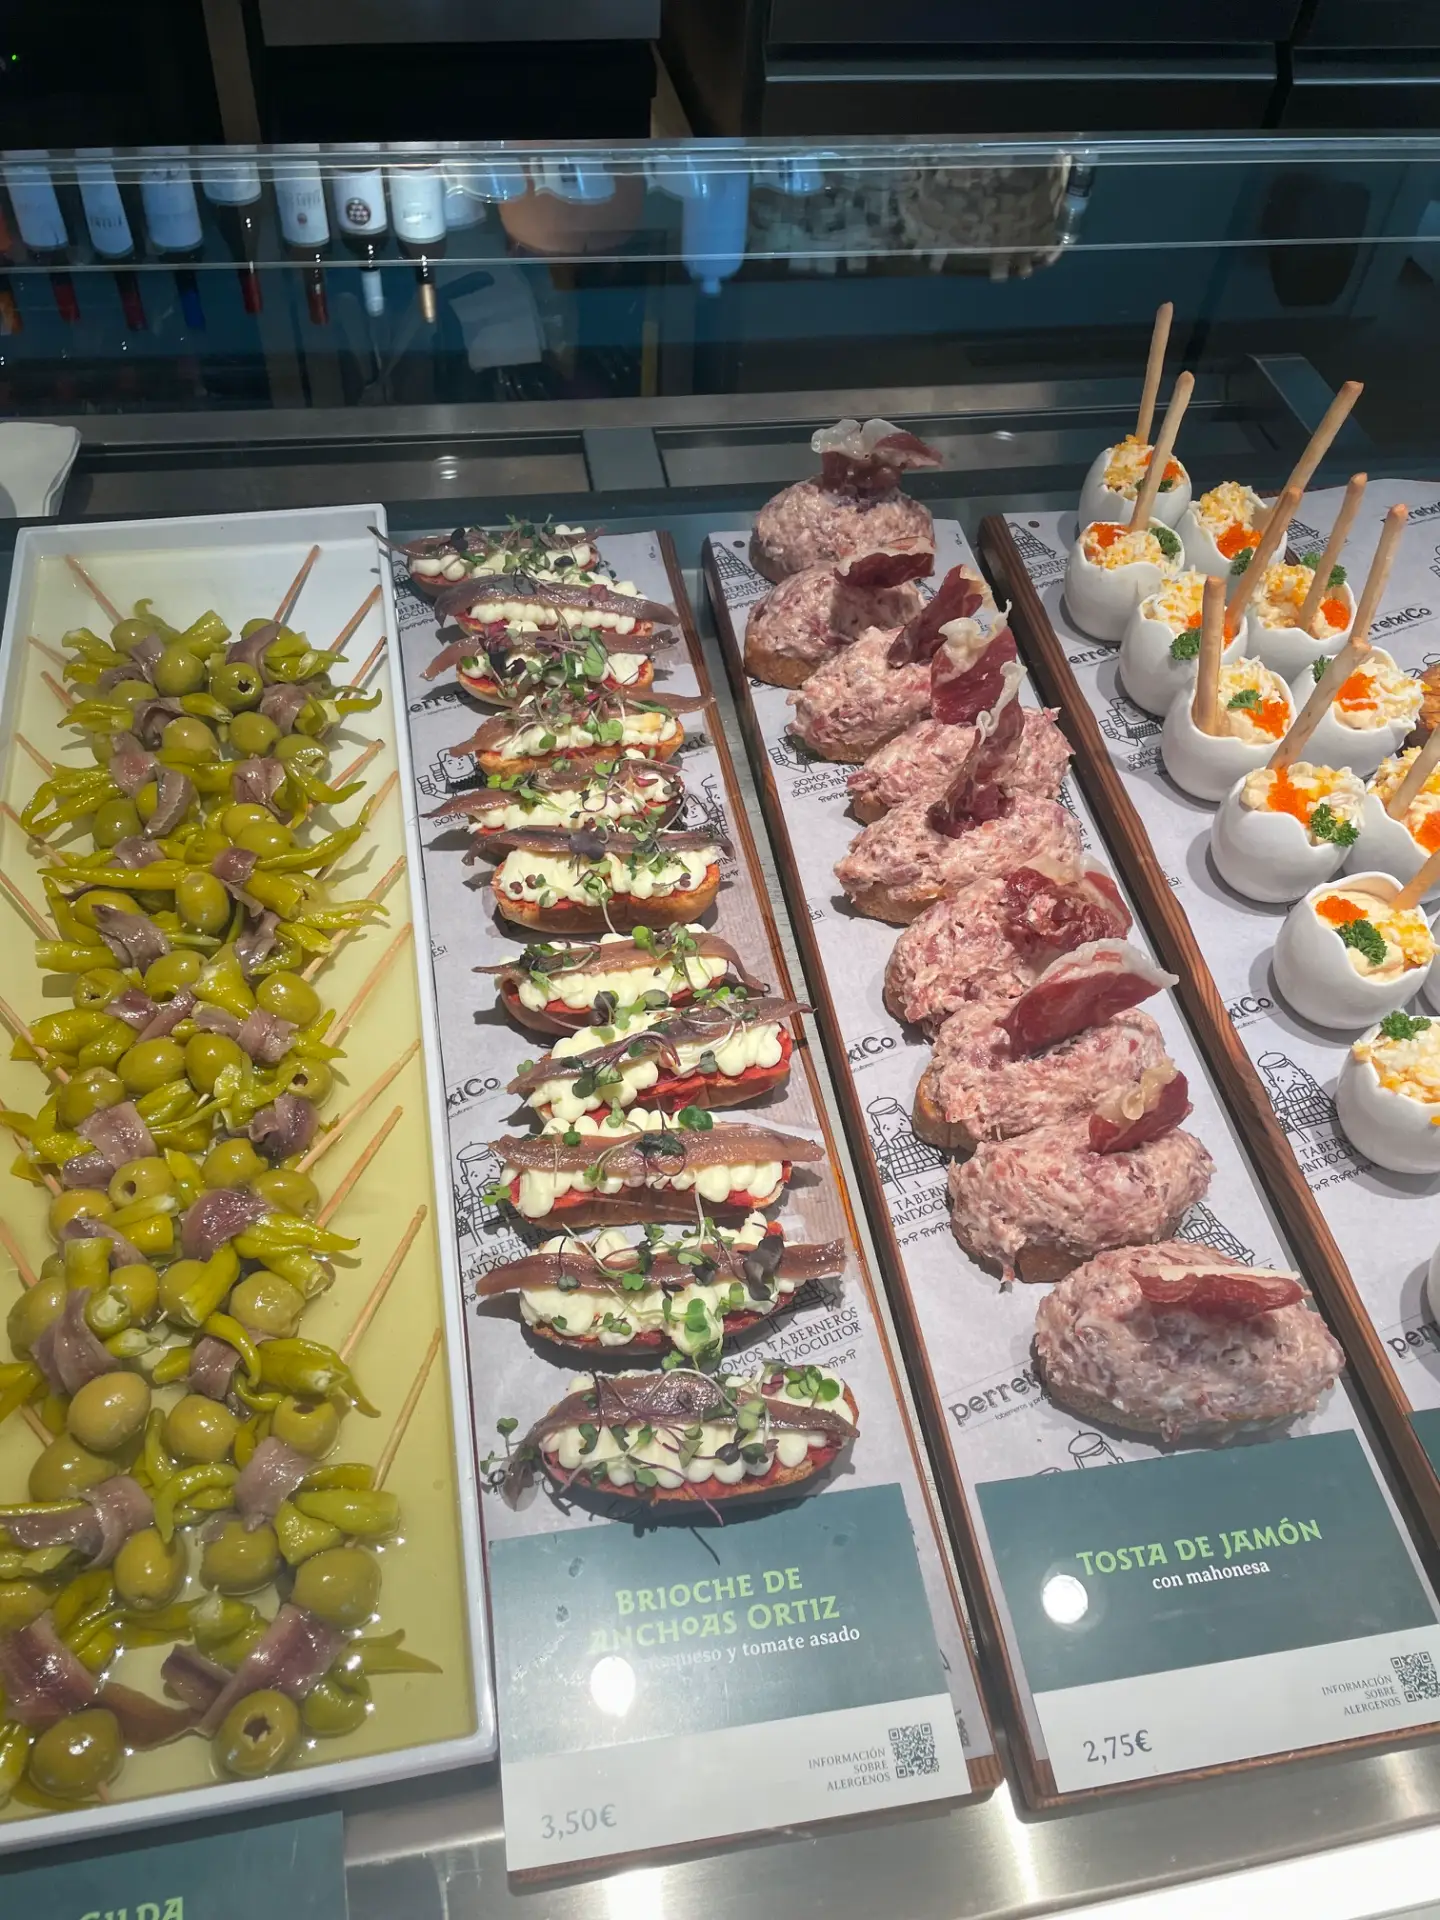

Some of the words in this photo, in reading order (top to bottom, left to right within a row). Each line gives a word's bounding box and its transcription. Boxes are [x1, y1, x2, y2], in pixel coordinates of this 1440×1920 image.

[766, 1306, 858, 1353] TABERNEROS
[1076, 1543, 1168, 1576] TOSTA
[1174, 1536, 1214, 1561] DE
[1219, 1517, 1322, 1560] JAMÓN
[615, 1574, 754, 1615] BRIOCHE
[762, 1567, 803, 1593] DE
[1152, 1573, 1183, 1590] con
[1187, 1561, 1270, 1585] mahonesa
[586, 1611, 738, 1655] ANCHOAS
[747, 1596, 840, 1630] ORTIZ
[727, 1646, 737, 1664] y
[742, 1635, 804, 1656] tomate
[810, 1625, 860, 1647] asado
[1321, 1671, 1393, 1696] INFORMACIÓN
[1364, 1686, 1398, 1700] SOBRE
[1343, 1697, 1402, 1716] ALERGENOS
[808, 1747, 886, 1770] INFORMACIÓN
[1082, 1729, 1152, 1765] 2,75€
[827, 1772, 891, 1791] ALERGENOS
[854, 1760, 889, 1774] SOBRE
[541, 1803, 617, 1842] 3,50€
